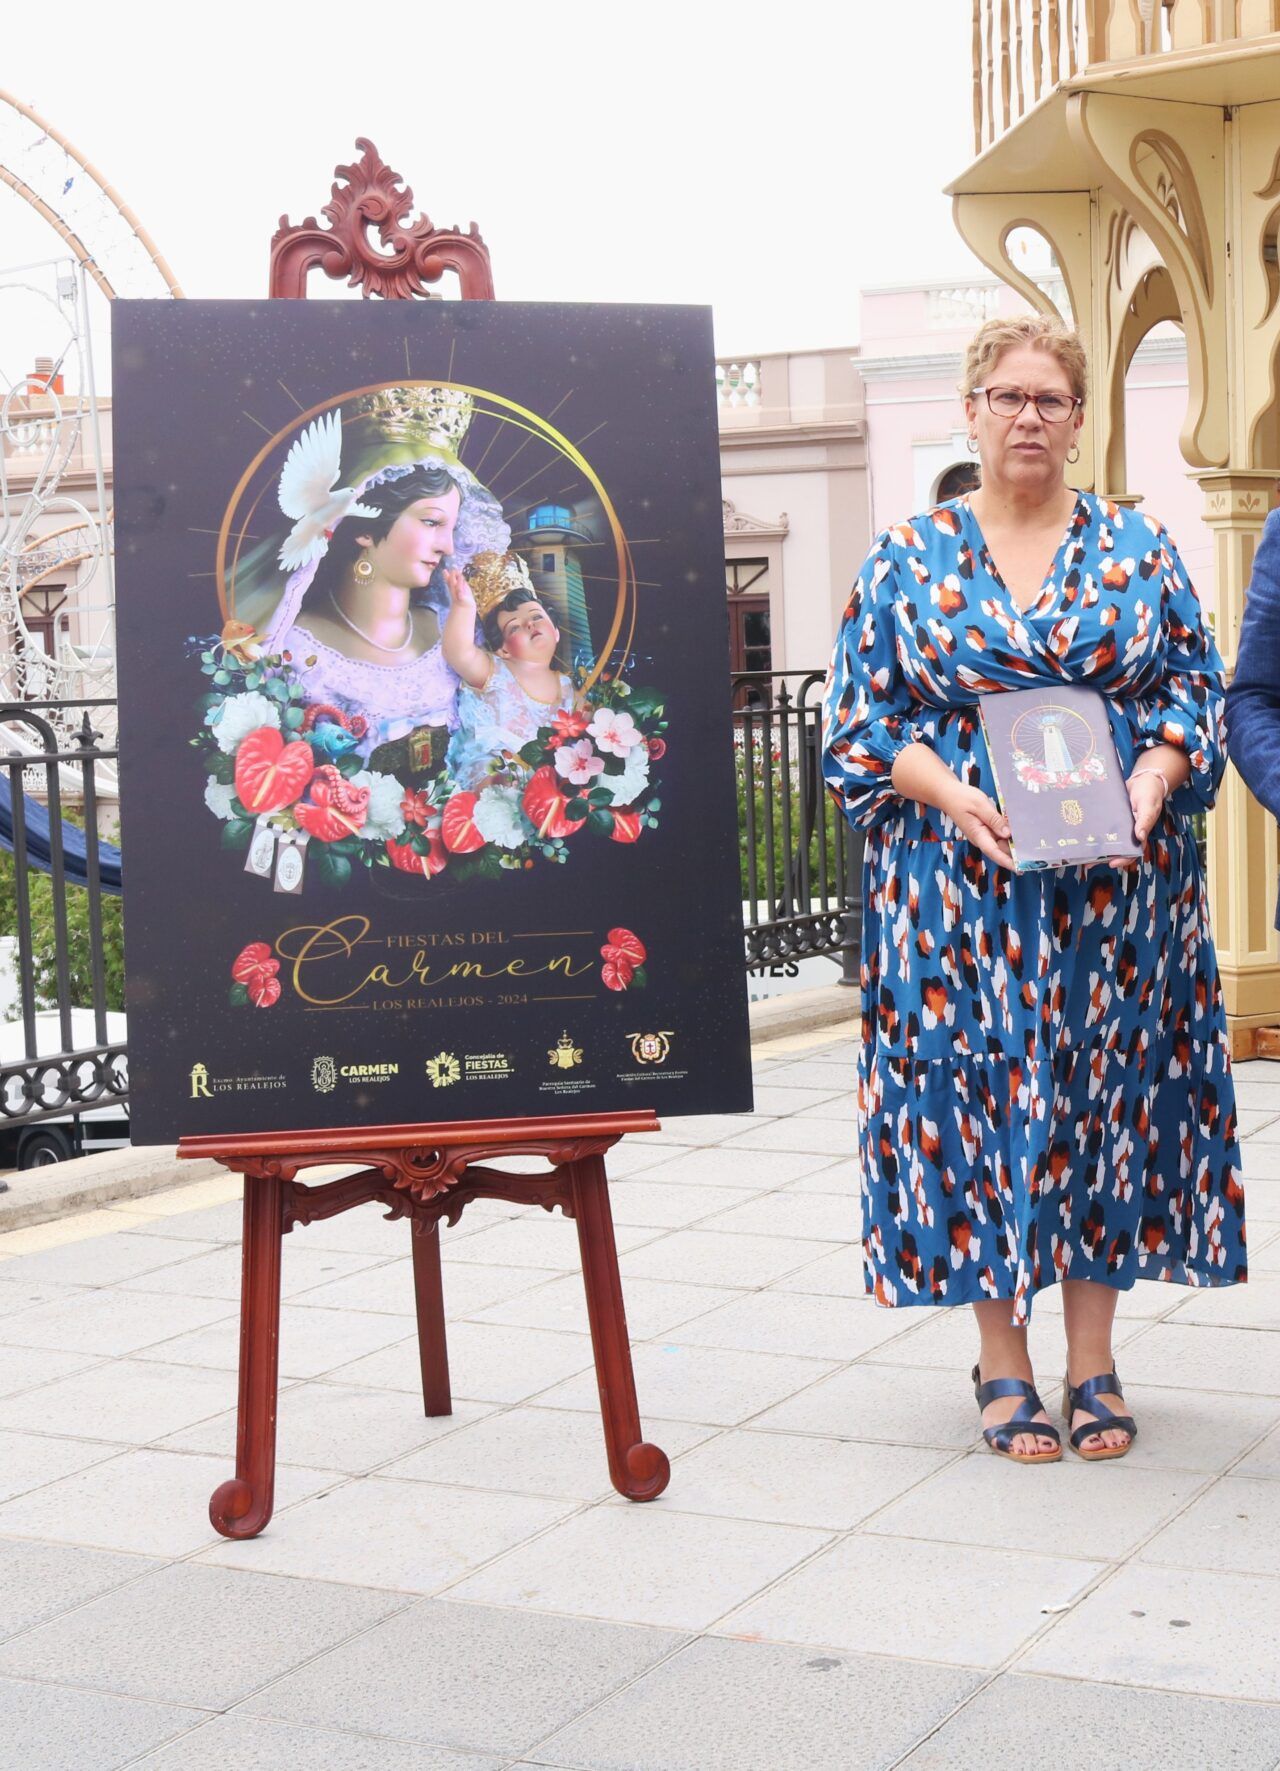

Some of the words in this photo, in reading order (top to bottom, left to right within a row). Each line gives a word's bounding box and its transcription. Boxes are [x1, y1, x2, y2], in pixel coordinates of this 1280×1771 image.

[387, 933, 465, 948] FIESTAS
[471, 931, 510, 945] DEL
[275, 914, 594, 1005] Carmen
[373, 999, 403, 1011] LOS
[407, 996, 485, 1010] REALEJOS
[497, 994, 528, 1005] 2024
[340, 1063, 399, 1077] CARMEN
[465, 1059, 508, 1070] FIESTAS
[362, 1075, 391, 1083] REALEJOS
[213, 1084, 233, 1092] LOS
[236, 1081, 287, 1091] REALEJOS
